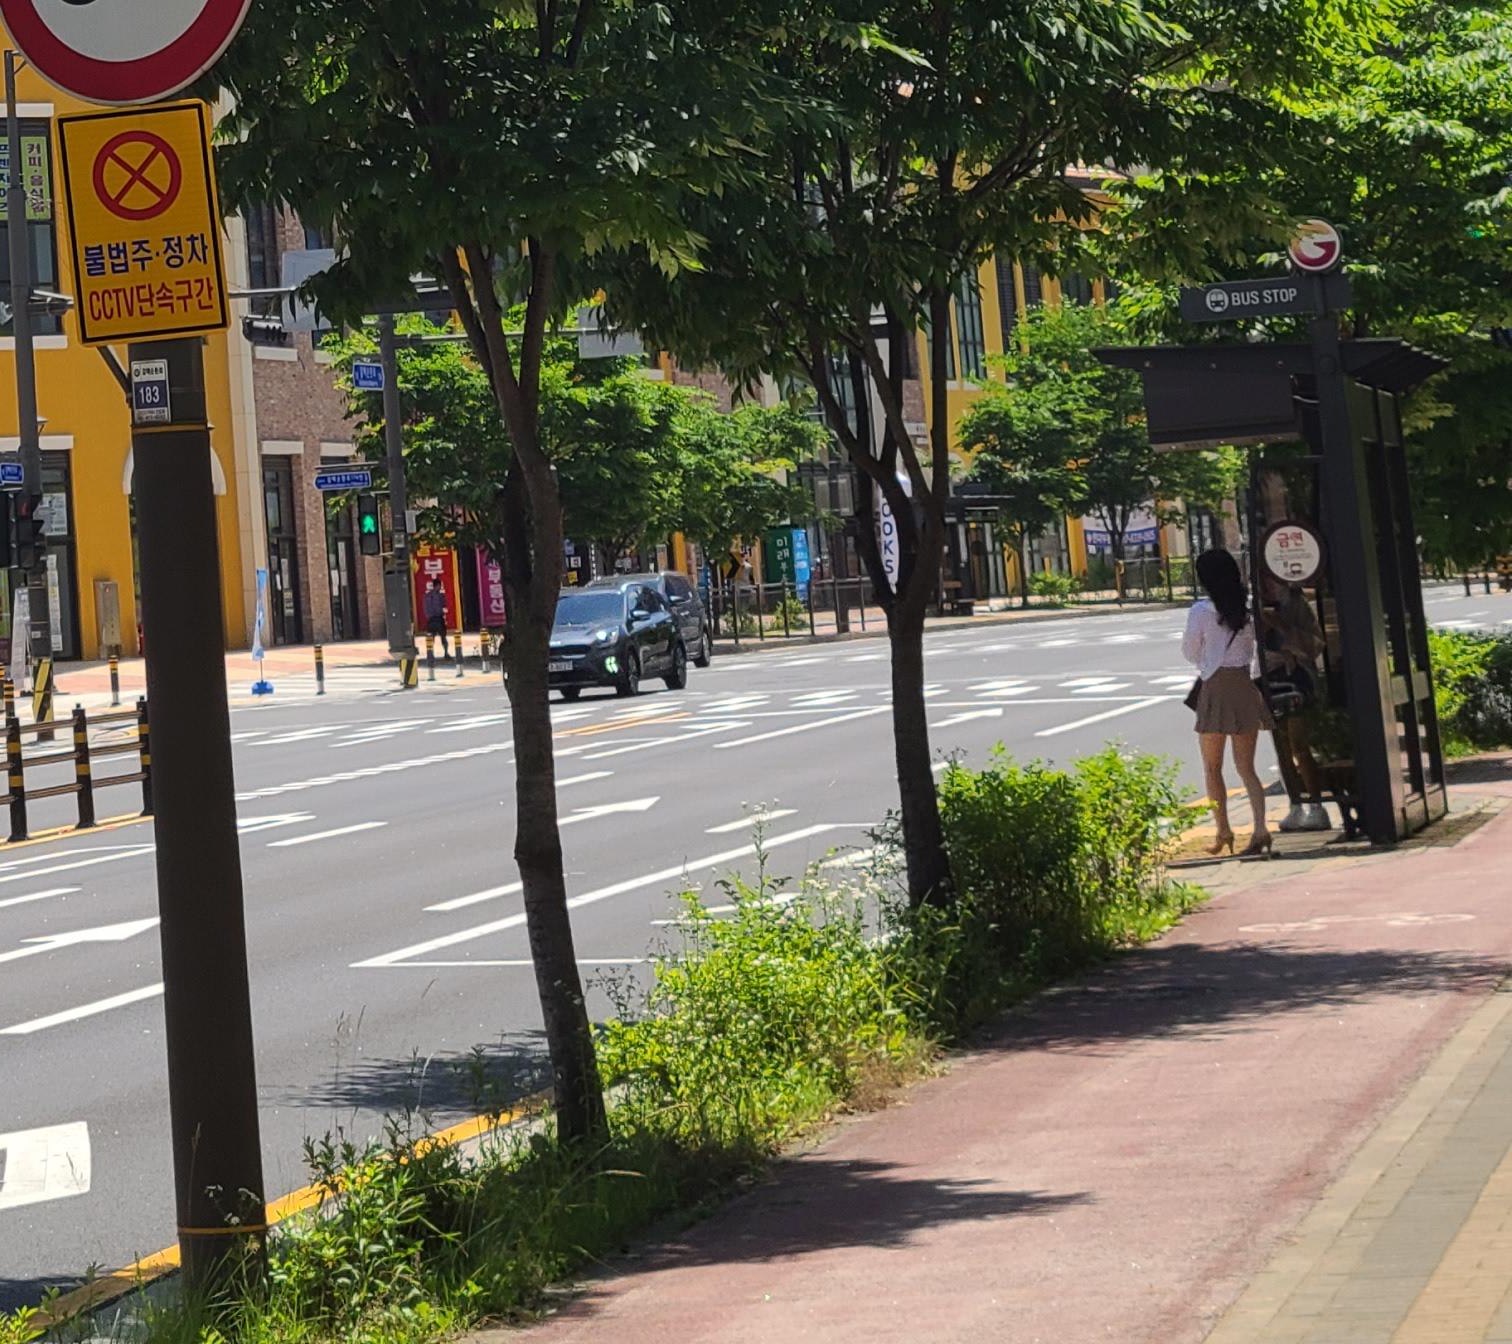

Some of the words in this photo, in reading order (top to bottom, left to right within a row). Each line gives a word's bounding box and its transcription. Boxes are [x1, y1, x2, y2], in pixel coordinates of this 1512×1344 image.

[89, 277, 213, 321] CCTV단속구간
[1231, 290, 1258, 306] BUS
[1263, 288, 1297, 304] STOP
[139, 385, 160, 404] 183
[881, 502, 894, 574] OOKS
